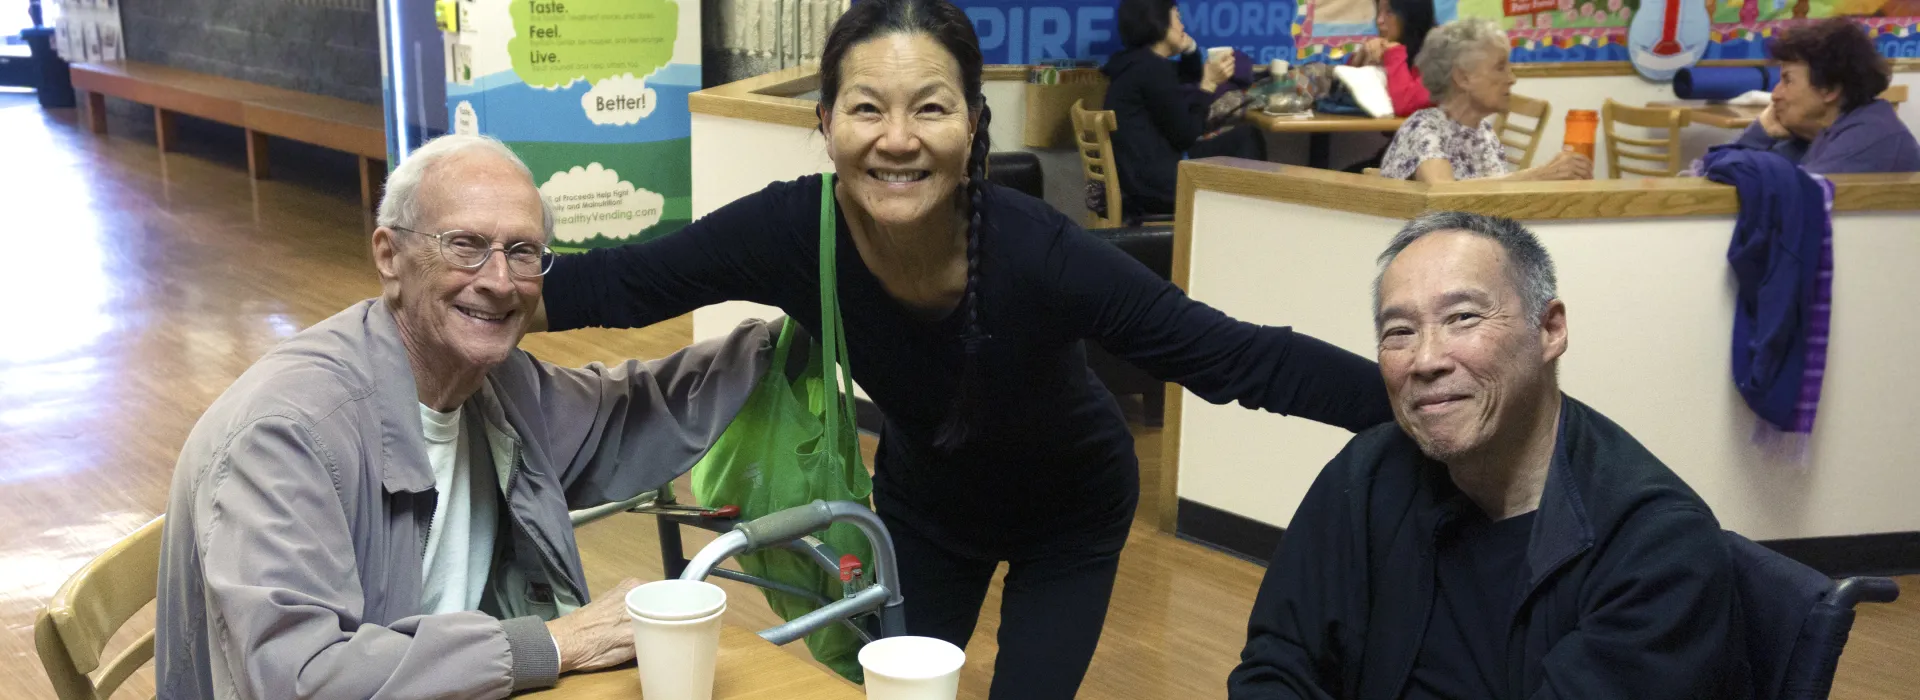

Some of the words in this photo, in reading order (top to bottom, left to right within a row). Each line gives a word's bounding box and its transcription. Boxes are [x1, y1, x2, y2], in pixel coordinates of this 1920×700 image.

[529, 0, 569, 14] Taste.
[529, 23, 562, 39] Feel.
[530, 50, 561, 64] Live.
[596, 93, 646, 111] Better!
[563, 193, 595, 202] Proceeds
[596, 191, 612, 200] Help
[566, 202, 581, 210] and
